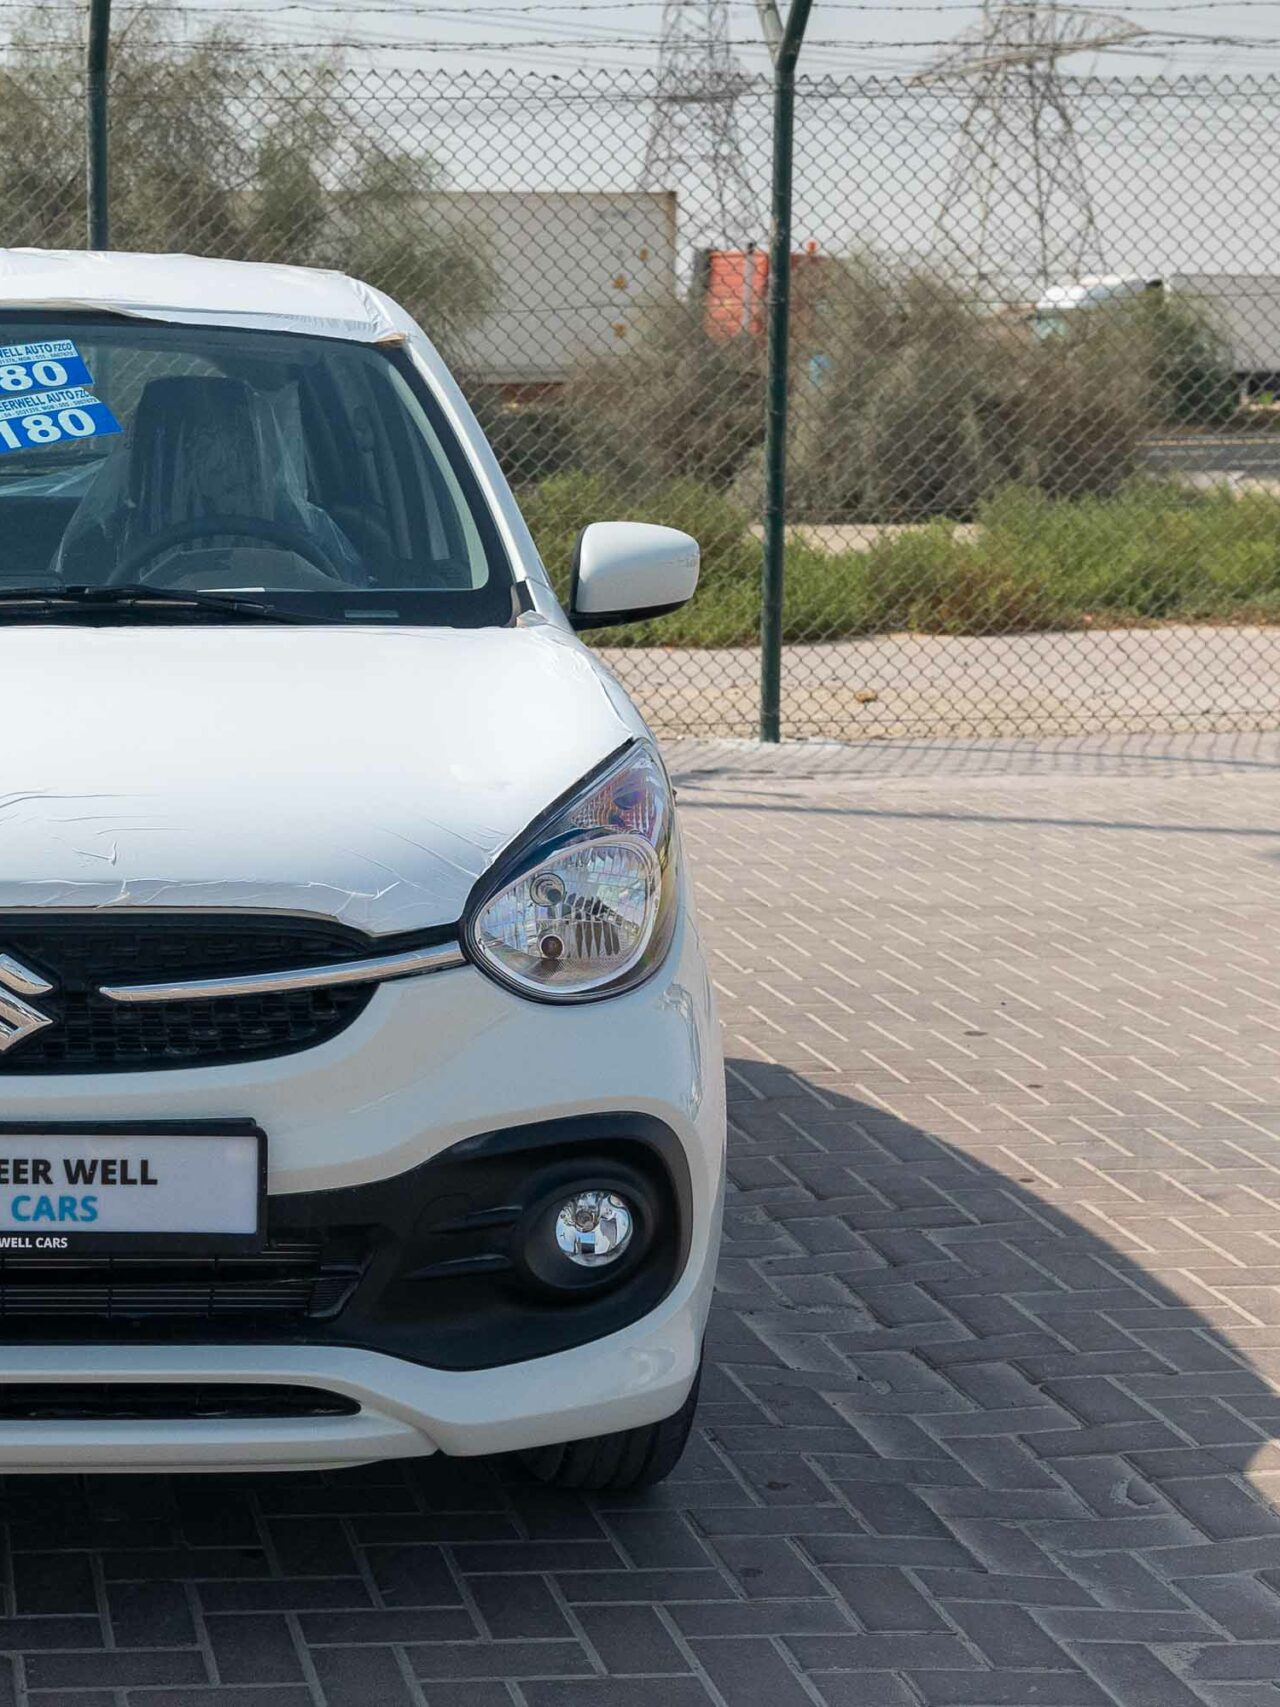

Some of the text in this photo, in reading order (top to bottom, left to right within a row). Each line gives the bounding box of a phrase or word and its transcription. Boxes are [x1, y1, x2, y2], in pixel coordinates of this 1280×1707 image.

[24, 343, 53, 356] AUTO
[46, 390, 75, 404] AUTO
[63, 1159, 158, 1186] WELL
[10, 1195, 99, 1222] CARS
[35, 1237, 69, 1249] CARS
